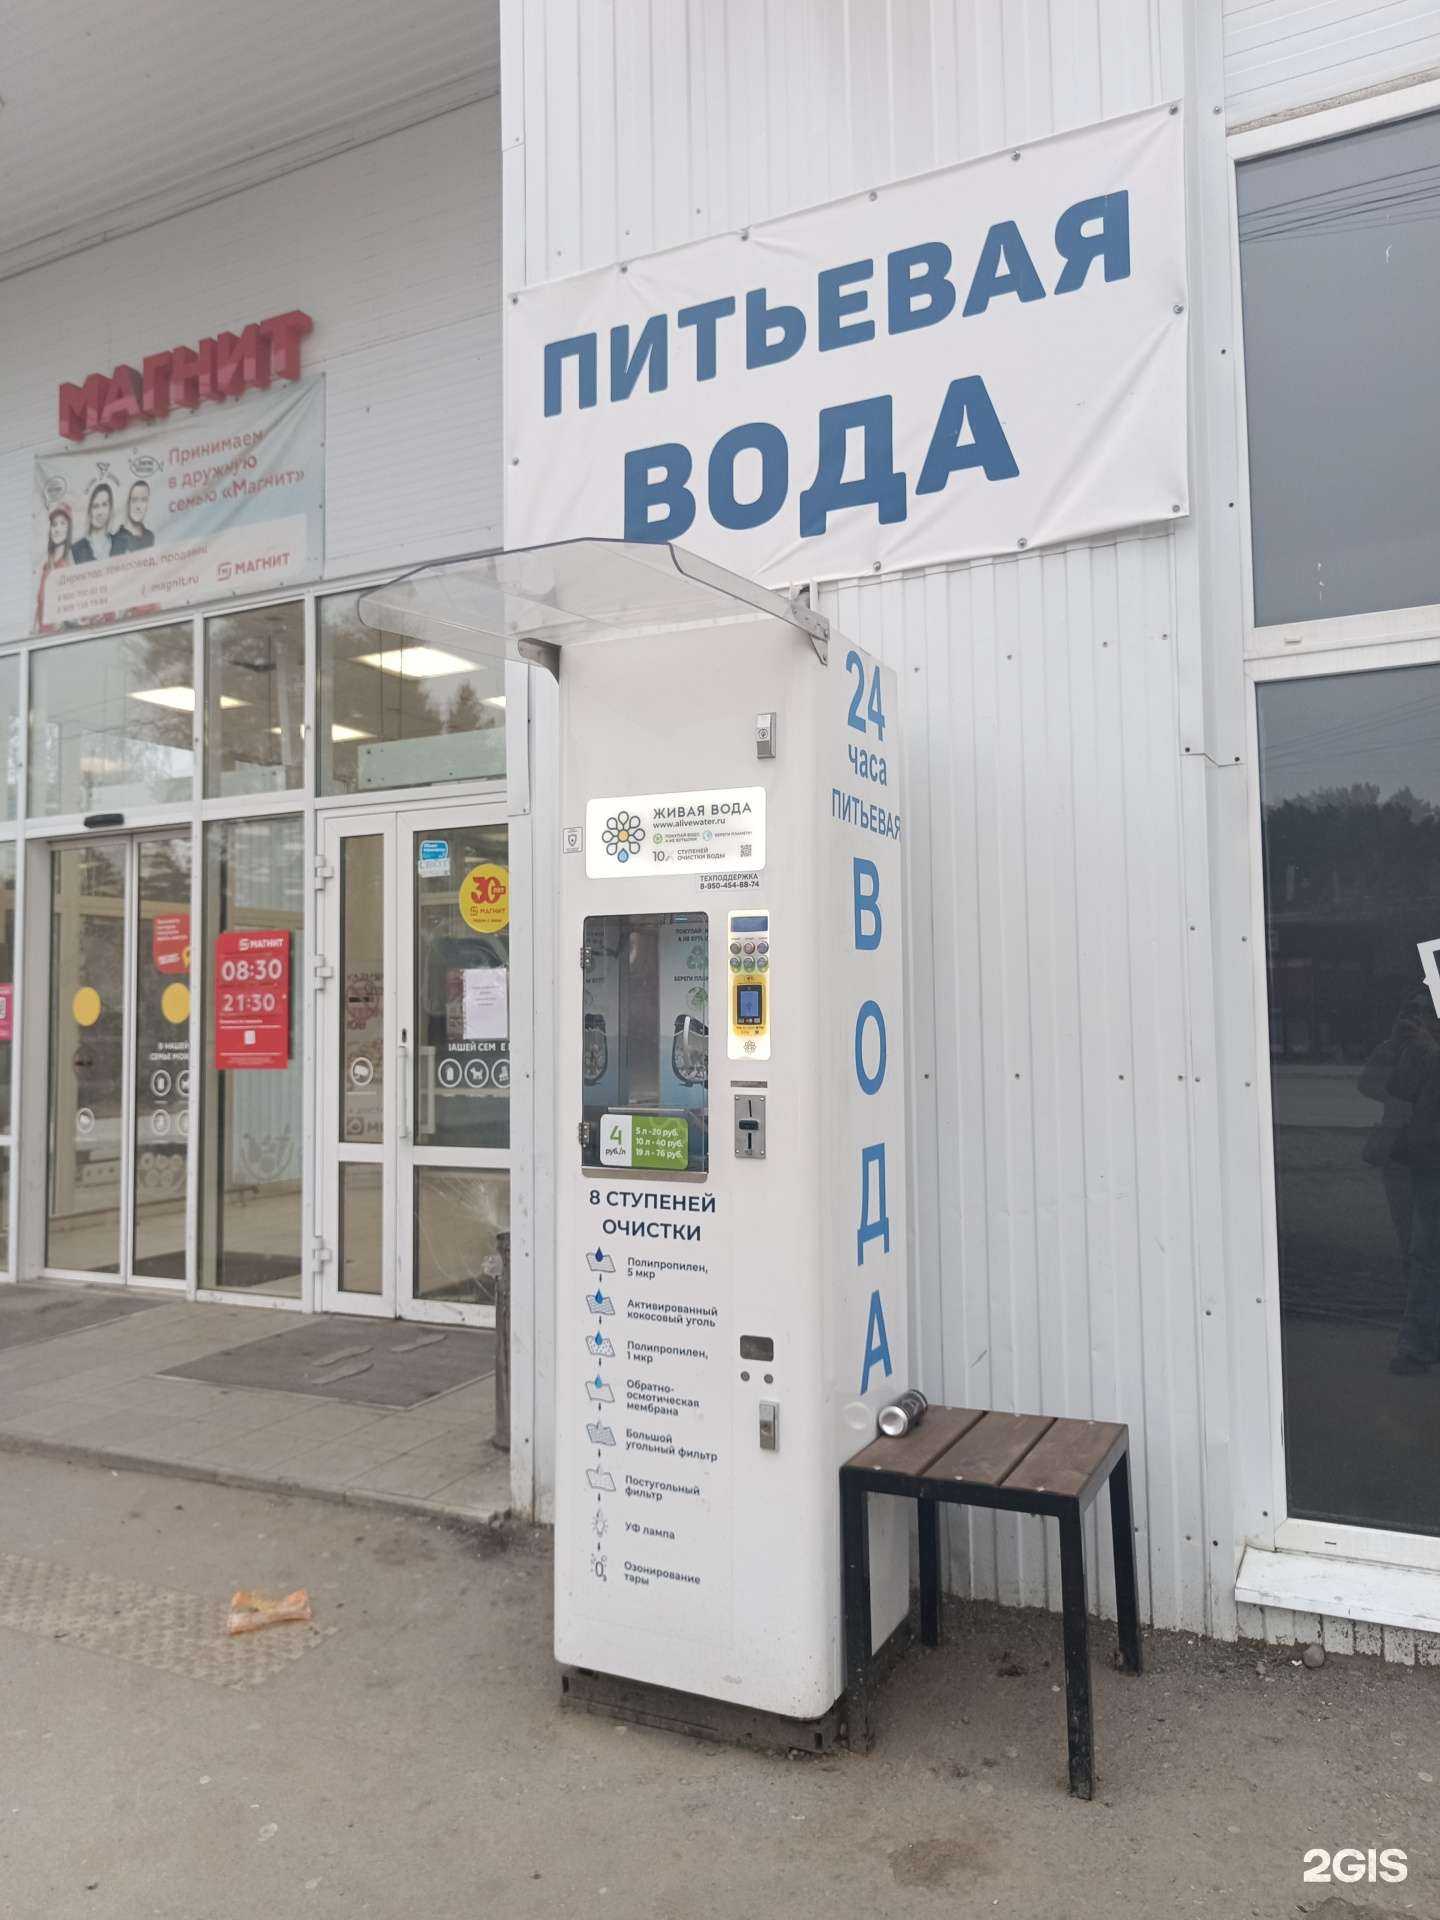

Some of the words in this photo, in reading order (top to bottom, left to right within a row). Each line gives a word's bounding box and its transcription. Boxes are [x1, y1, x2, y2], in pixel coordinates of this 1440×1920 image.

[543, 189, 1132, 418] ПИТЬЕВАЯ
[59, 309, 313, 443] МАГНИТ
[168, 429, 268, 465] Принимаем
[623, 374, 1021, 544] ВОДА
[168, 476, 177, 489] в
[182, 455, 258, 490] дружную
[168, 488, 217, 513] семью
[223, 469, 305, 499] «Магнит»
[234, 552, 291, 575] МАГНИТ
[845, 650, 886, 742] 24
[848, 743, 888, 787] часа
[652, 804, 706, 820] ЖИВАЯ
[711, 801, 752, 816] ВОДА
[831, 787, 901, 841] ПИТЬЕВАЯ
[652, 817, 726, 829] www.alivewater.ru
[677, 847, 709, 855] СТУПЕНЕЙ
[700, 873, 759, 882] ТЕХПОДДЕРЖКА
[471, 875, 501, 904] 30
[249, 938, 284, 949] МАГНИТ
[221, 958, 283, 982] 08:30
[222, 993, 276, 1013] 21:30
[609, 1125, 622, 1145] 4
[635, 1127, 641, 1135] 5
[652, 1128, 661, 1136] 20
[662, 1128, 679, 1137] руб.
[853, 857, 892, 1396] ВОДА
[636, 1137, 644, 1145] 10
[656, 1139, 666, 1147] 40
[666, 1150, 684, 1160] руб.
[589, 1189, 601, 1206] 8
[606, 1190, 716, 1213] СТУПЕНЕЙ
[602, 1219, 701, 1242] ОЧИСТКИ
[627, 1256, 709, 1275] Полипропилен,
[627, 1267, 634, 1277] 5
[635, 1269, 656, 1281] мкр
[627, 1299, 719, 1317] Активированный
[627, 1311, 683, 1325] кокосовый
[685, 1317, 716, 1328] уголь
[626, 1351, 631, 1360] 1
[632, 1352, 654, 1365] мкр
[627, 1340, 709, 1361] Полипропилен,
[626, 1379, 675, 1394] Обратно-
[626, 1391, 700, 1408] осмотическая
[626, 1401, 679, 1416] мембрана
[625, 1428, 673, 1444] Большой
[625, 1440, 676, 1455] угольный
[677, 1447, 718, 1463] фильтр
[624, 1487, 663, 1502] фильтр
[625, 1474, 701, 1496] Постугольный
[624, 1521, 641, 1533] УФ
[642, 1525, 676, 1540] лампа
[624, 1560, 701, 1585] Озонирование
[624, 1572, 650, 1586] тары
